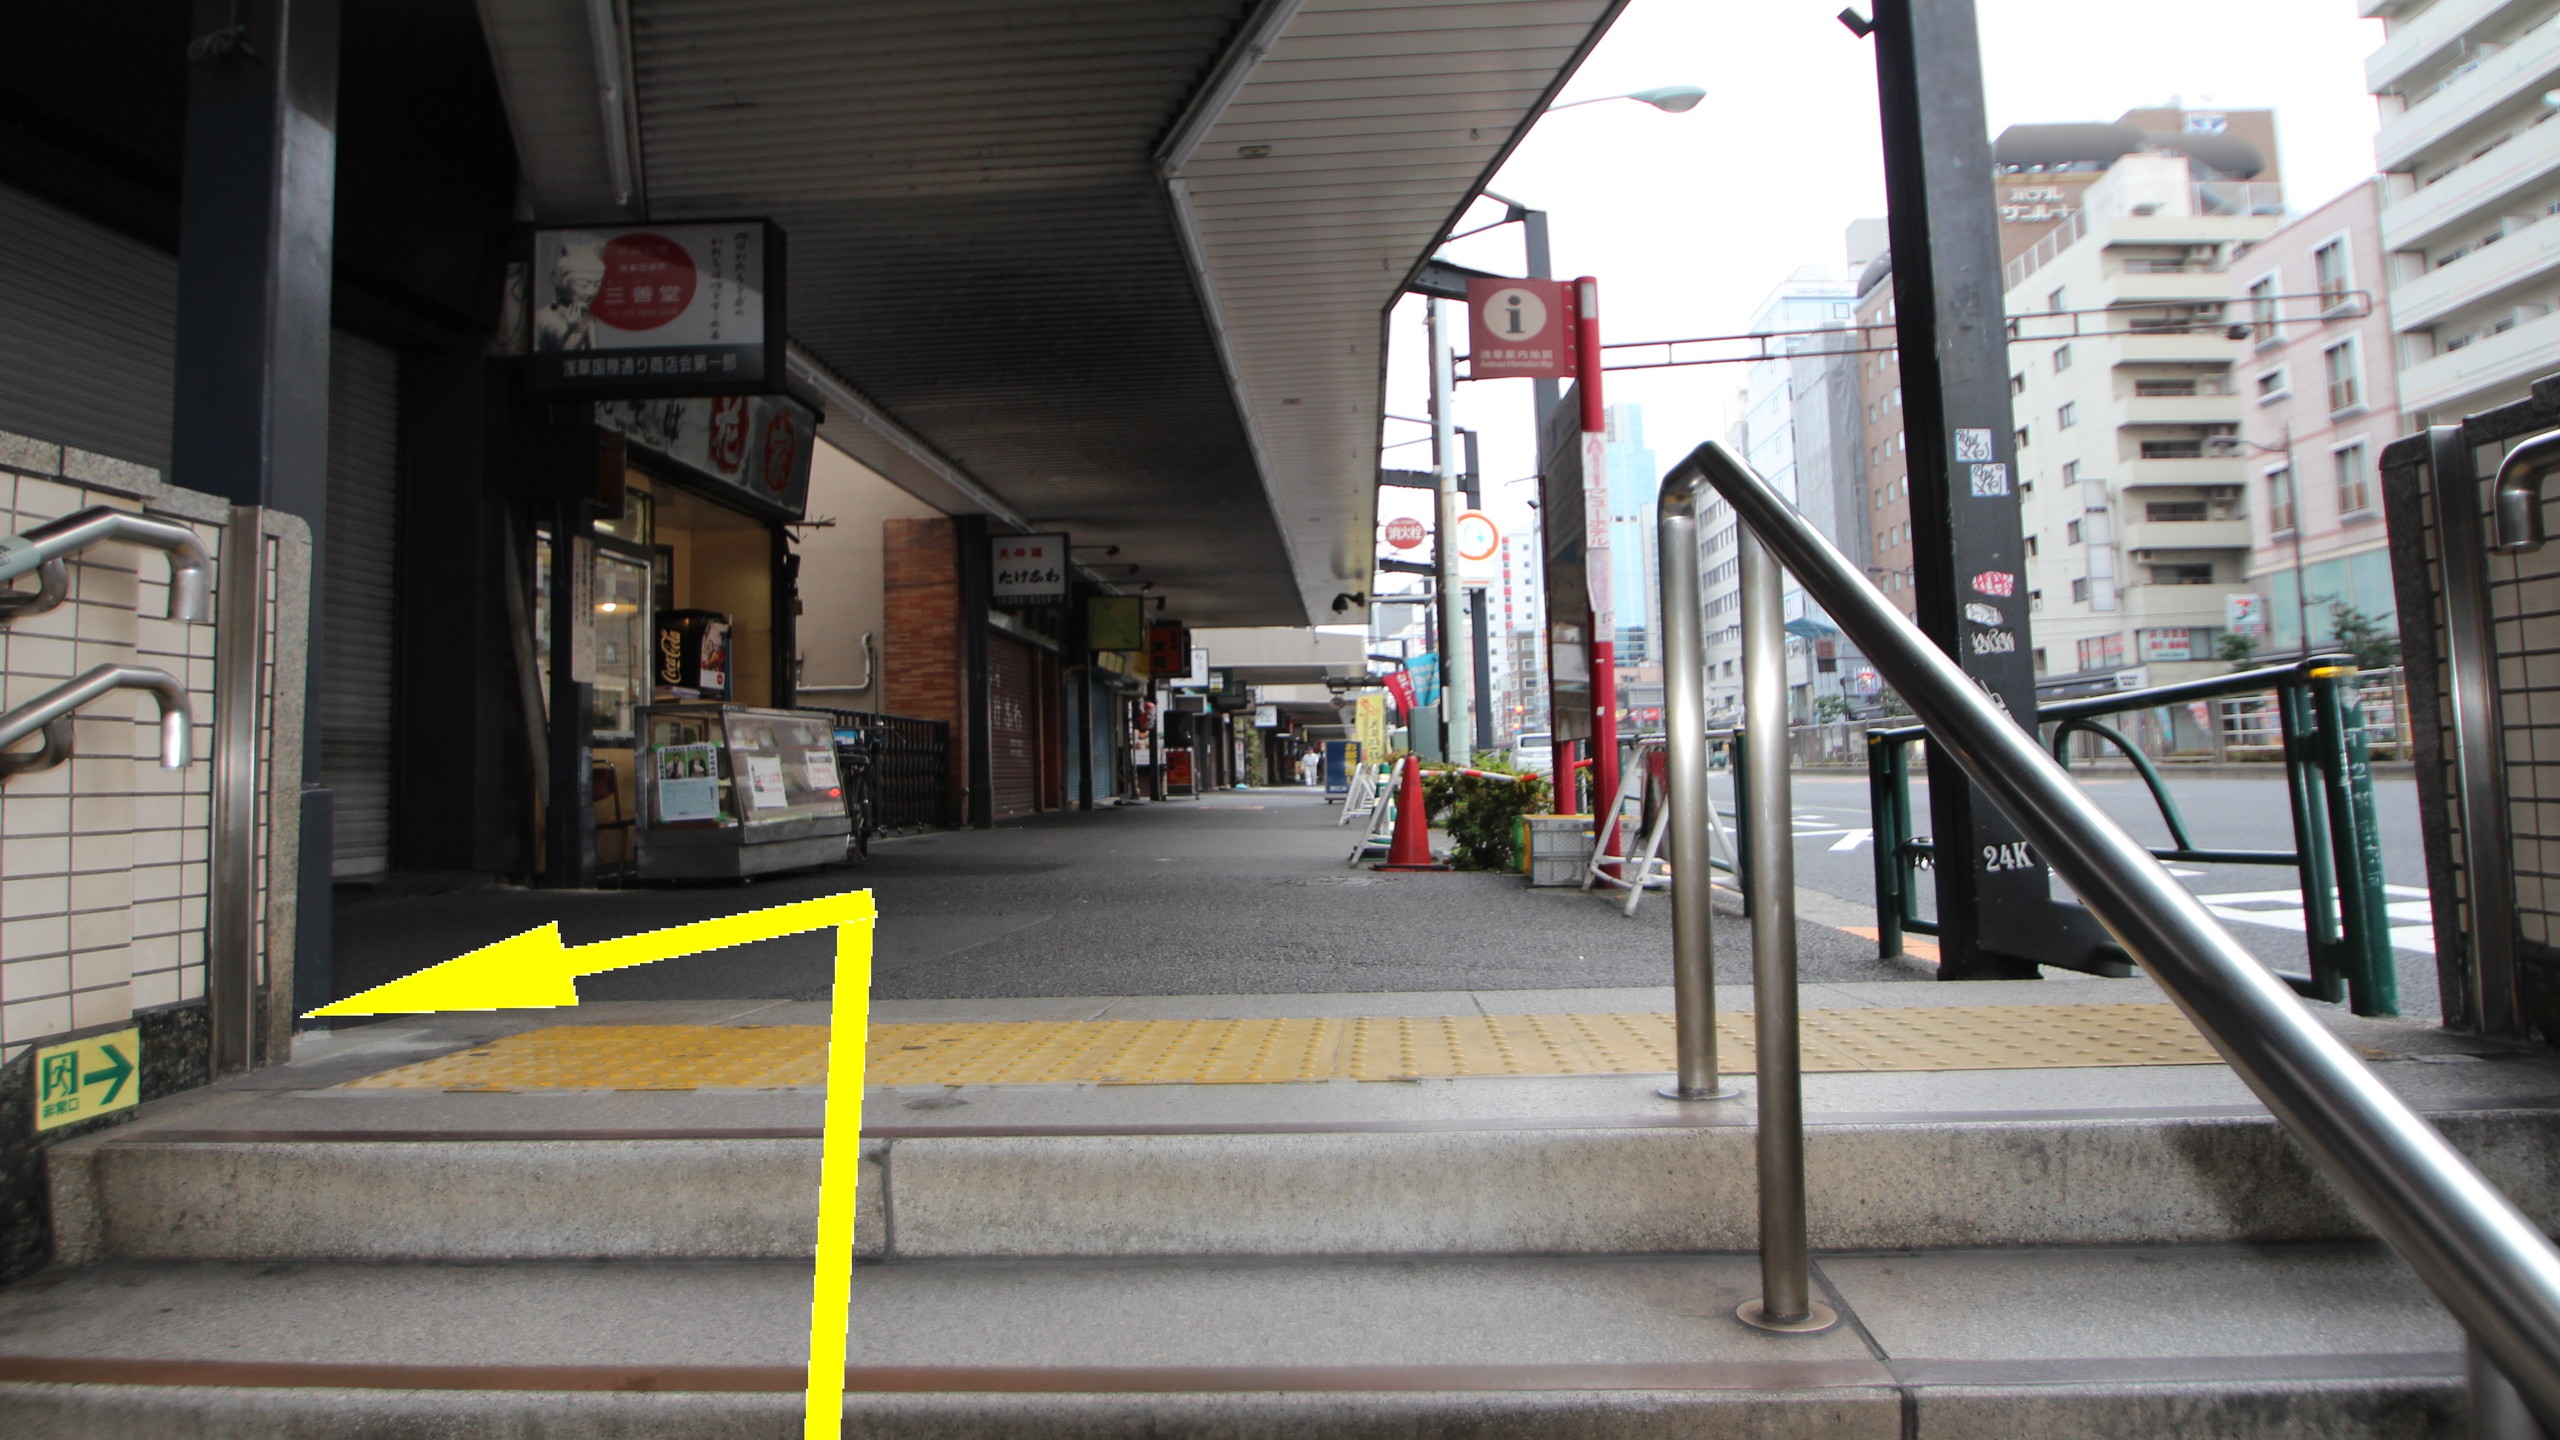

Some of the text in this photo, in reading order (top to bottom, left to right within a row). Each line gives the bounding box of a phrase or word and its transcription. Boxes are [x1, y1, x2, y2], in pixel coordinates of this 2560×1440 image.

[2008, 185, 2065, 203] ホテル
[604, 285, 682, 304] 三善堂
[1389, 525, 1422, 541] 消火栓
[1983, 841, 2035, 873] 24K
[42, 1098, 80, 1119] 非常口
